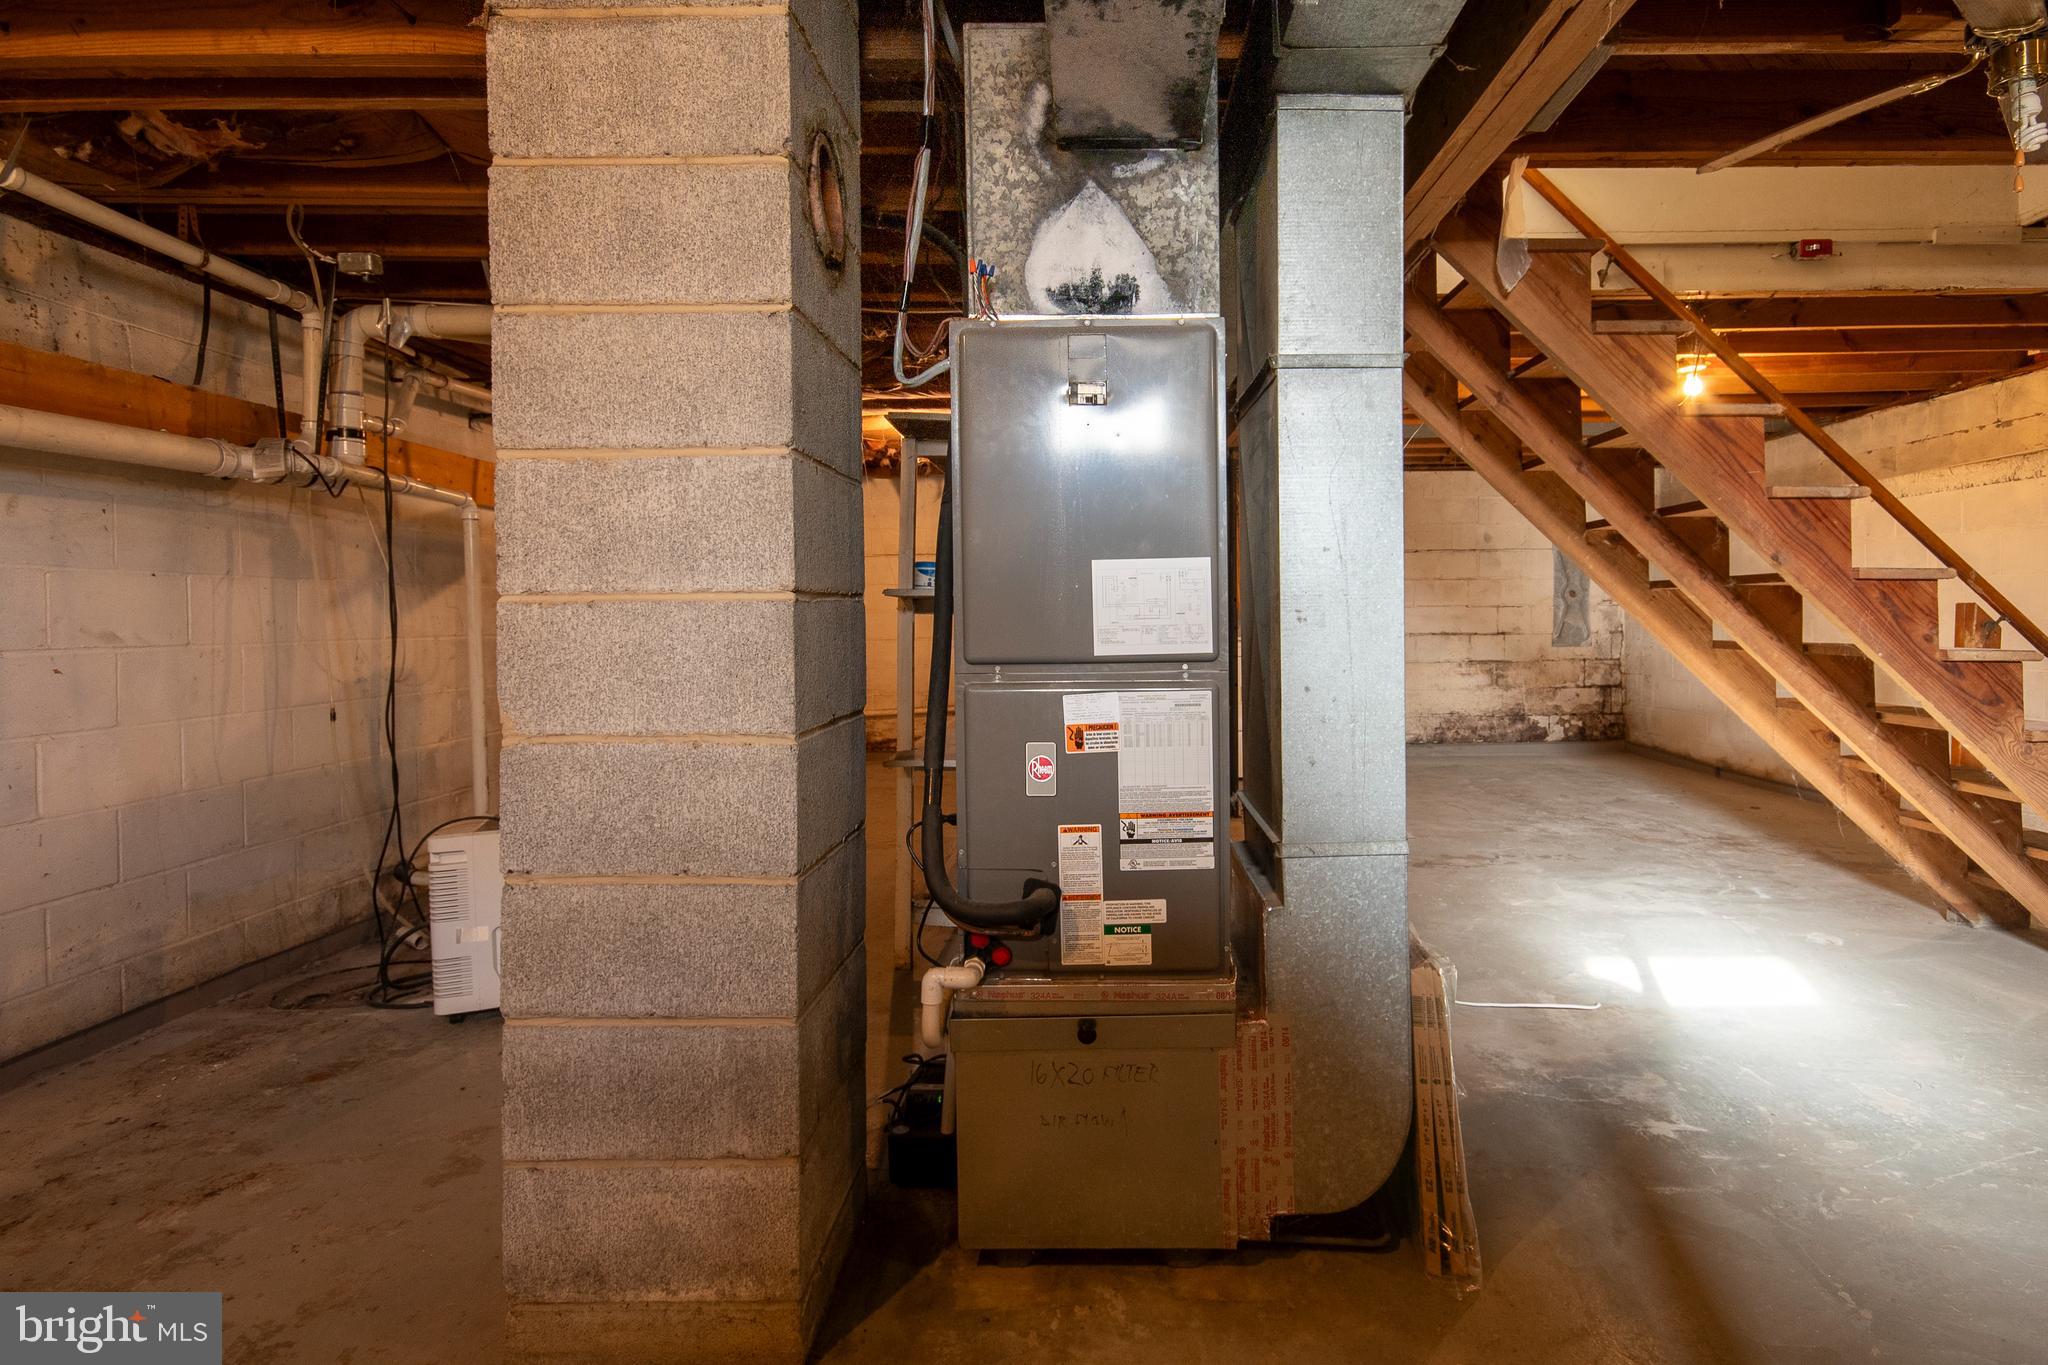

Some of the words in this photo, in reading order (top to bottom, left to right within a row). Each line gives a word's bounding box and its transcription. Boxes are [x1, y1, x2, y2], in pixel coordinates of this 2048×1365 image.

[1031, 756, 1053, 778] Rheem
[1114, 926, 1142, 934] NOTICE
[1030, 1059, 1094, 1089] 16X20
[1103, 1062, 1160, 1087] FILTER
[1425, 1180, 1434, 1192] EZ
